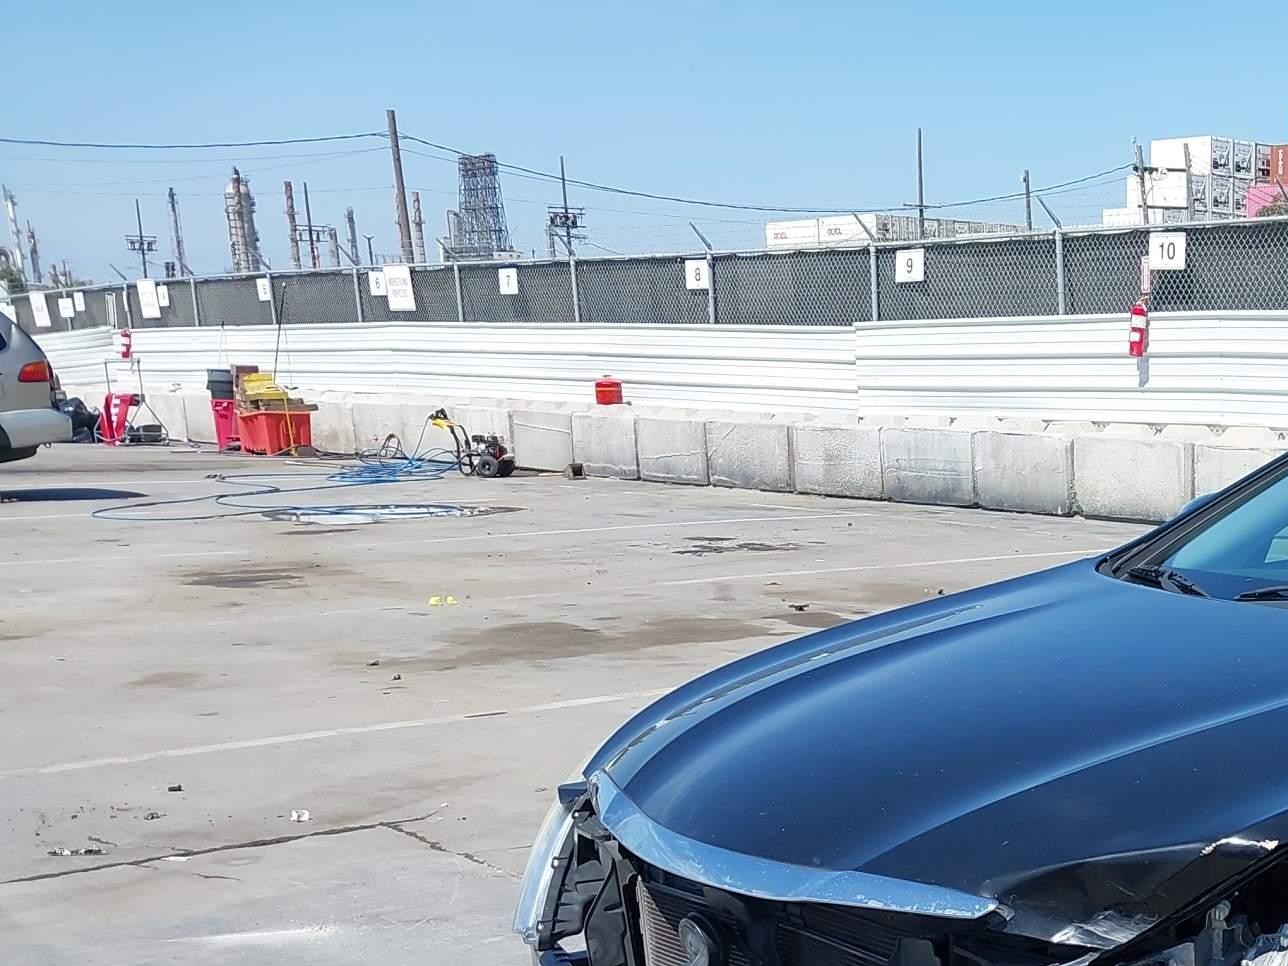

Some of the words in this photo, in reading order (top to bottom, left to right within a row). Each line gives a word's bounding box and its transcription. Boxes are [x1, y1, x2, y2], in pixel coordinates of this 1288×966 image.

[1159, 242, 1176, 260] 10
[906, 257, 913, 274] 9
[505, 274, 511, 288] 7
[694, 267, 701, 282] 8
[375, 277, 380, 289] 6
